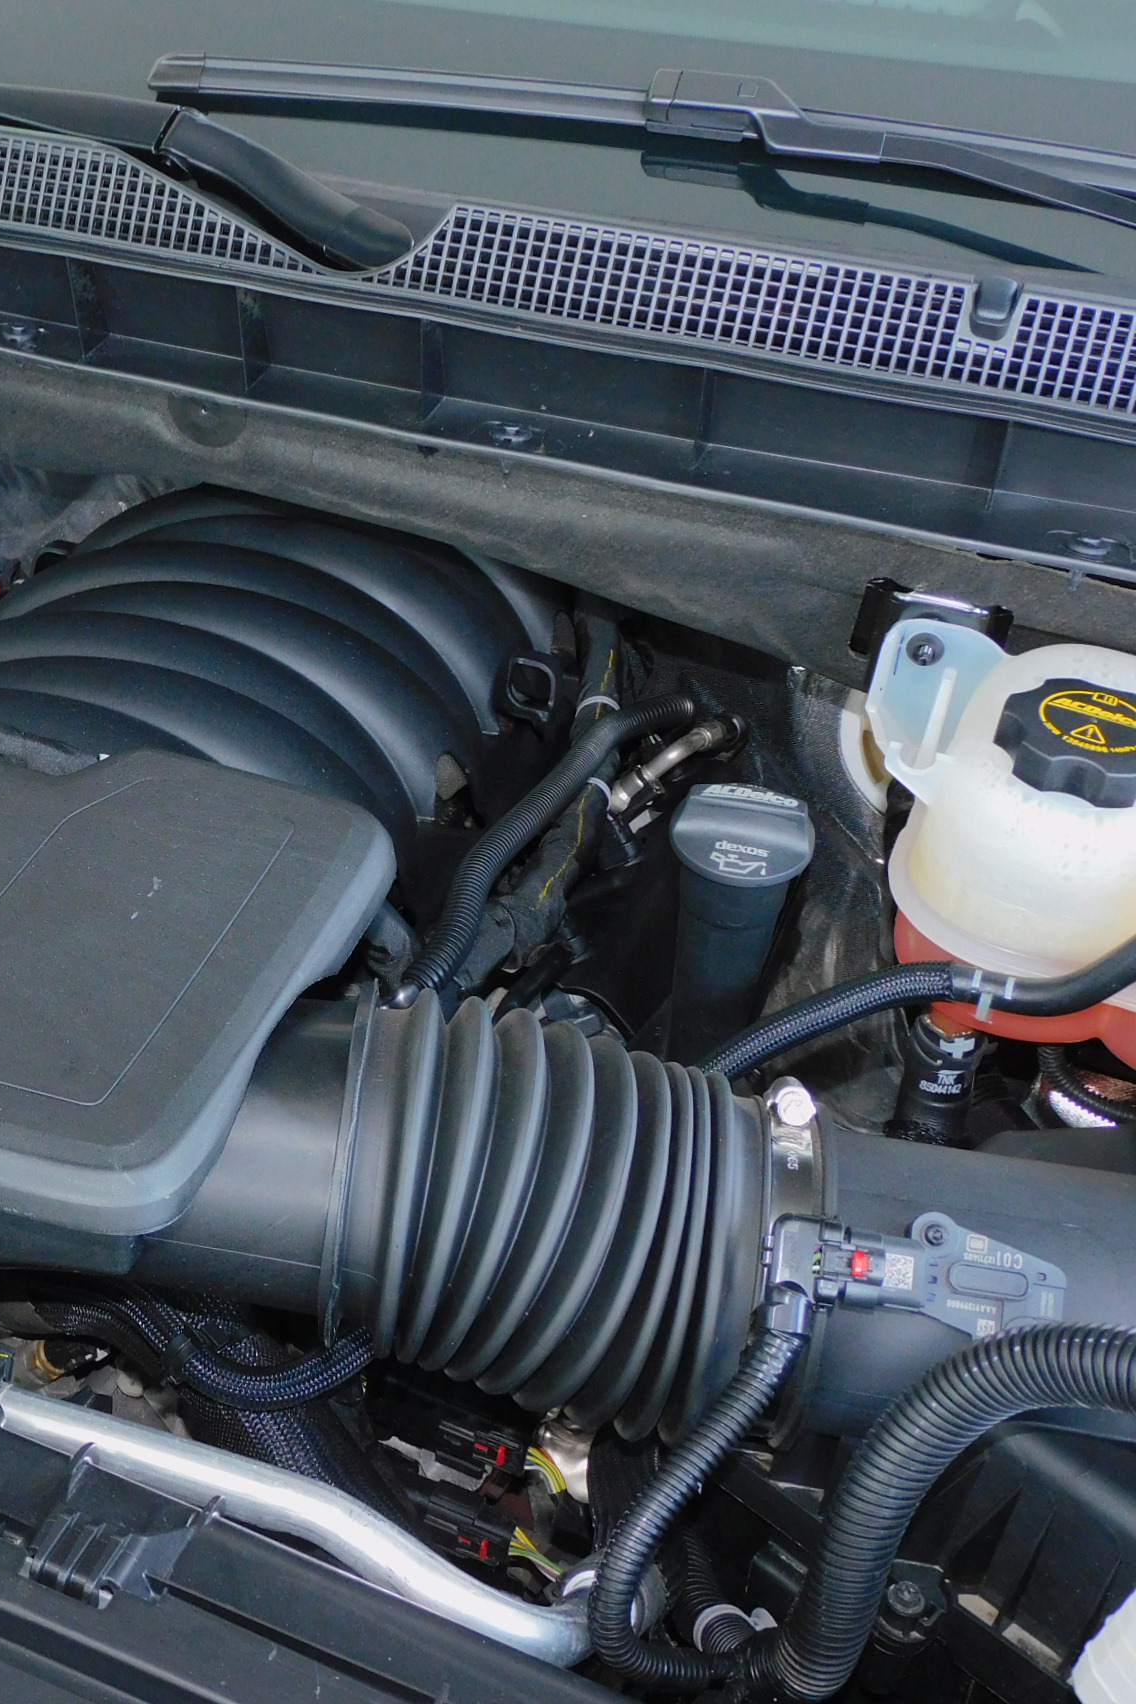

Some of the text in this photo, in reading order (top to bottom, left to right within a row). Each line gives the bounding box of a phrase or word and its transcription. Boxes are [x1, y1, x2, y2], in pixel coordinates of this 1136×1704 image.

[1048, 697, 1136, 728] ACDelc
[702, 784, 799, 807] ACDelco
[715, 840, 769, 858] dexos
